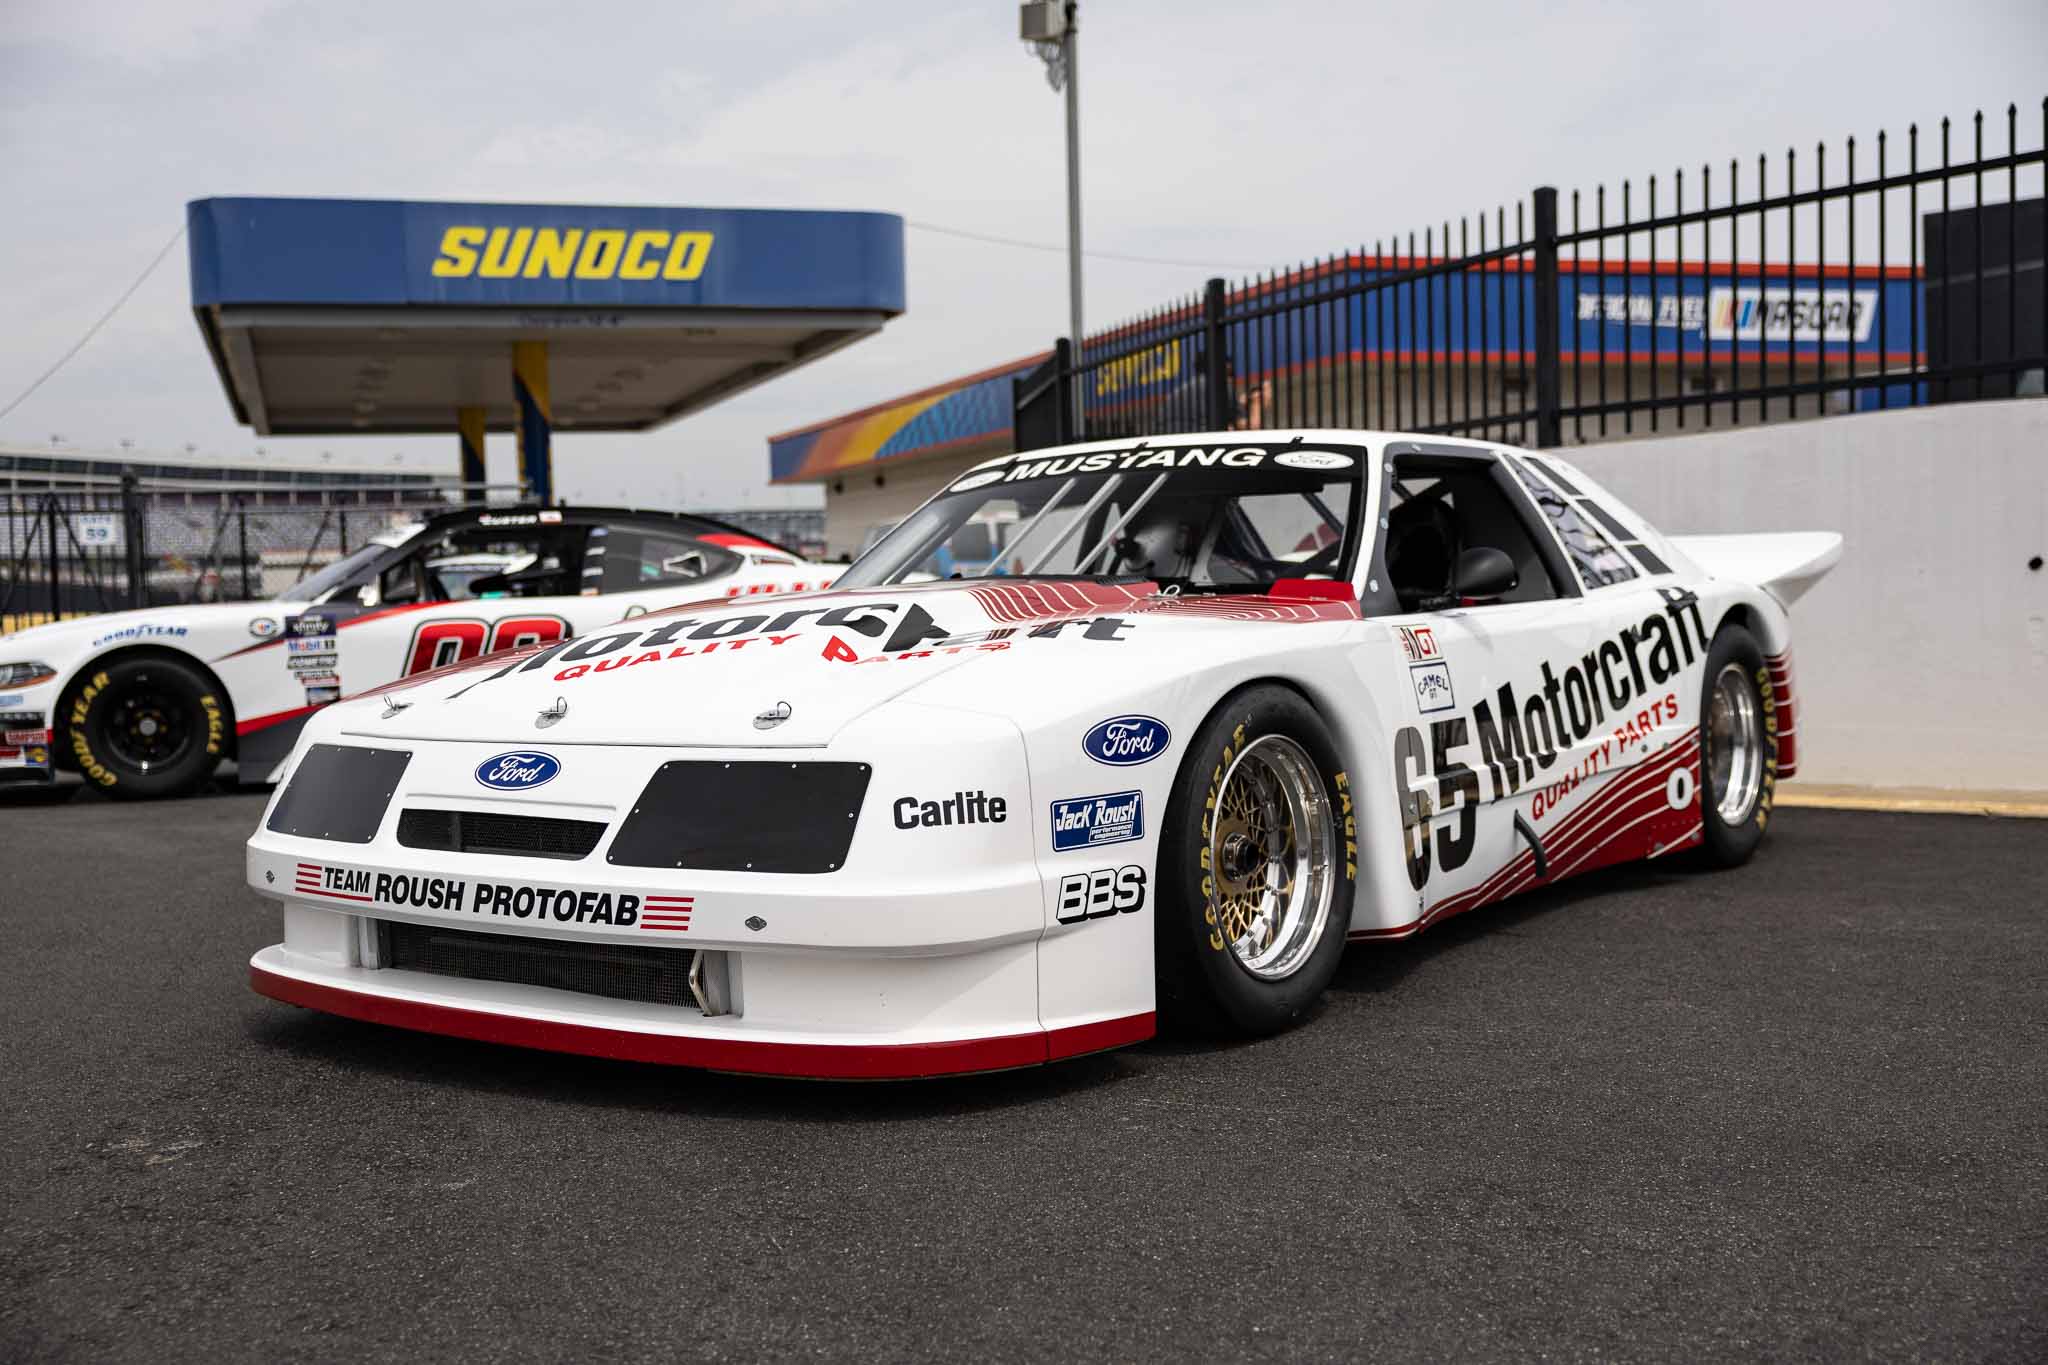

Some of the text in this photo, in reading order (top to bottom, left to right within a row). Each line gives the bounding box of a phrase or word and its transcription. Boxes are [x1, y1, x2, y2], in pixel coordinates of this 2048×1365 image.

[431, 227, 714, 281] SUNOCO
[1750, 299, 1864, 331] NASCAR
[1003, 447, 1267, 483] MUSTANG
[92, 624, 188, 646] GOODYEAR
[553, 632, 1011, 682] QUALITY PARTS
[1418, 674, 1448, 696] CAMEL
[1472, 586, 1711, 804] Motorcraft
[200, 694, 224, 753] EAGLE
[1101, 723, 1156, 756] Ford
[489, 758, 542, 783] Ford
[1530, 738, 1612, 821] QUALITY
[1616, 693, 1679, 752] PARTS
[893, 790, 1006, 830] Carlite
[1055, 802, 1093, 832] Jack
[1333, 770, 1359, 881] EAGLE
[1394, 717, 1480, 892] 65
[324, 867, 641, 927] TEAM ROUSH PROTOFAB
[1056, 864, 1148, 925] BBS
